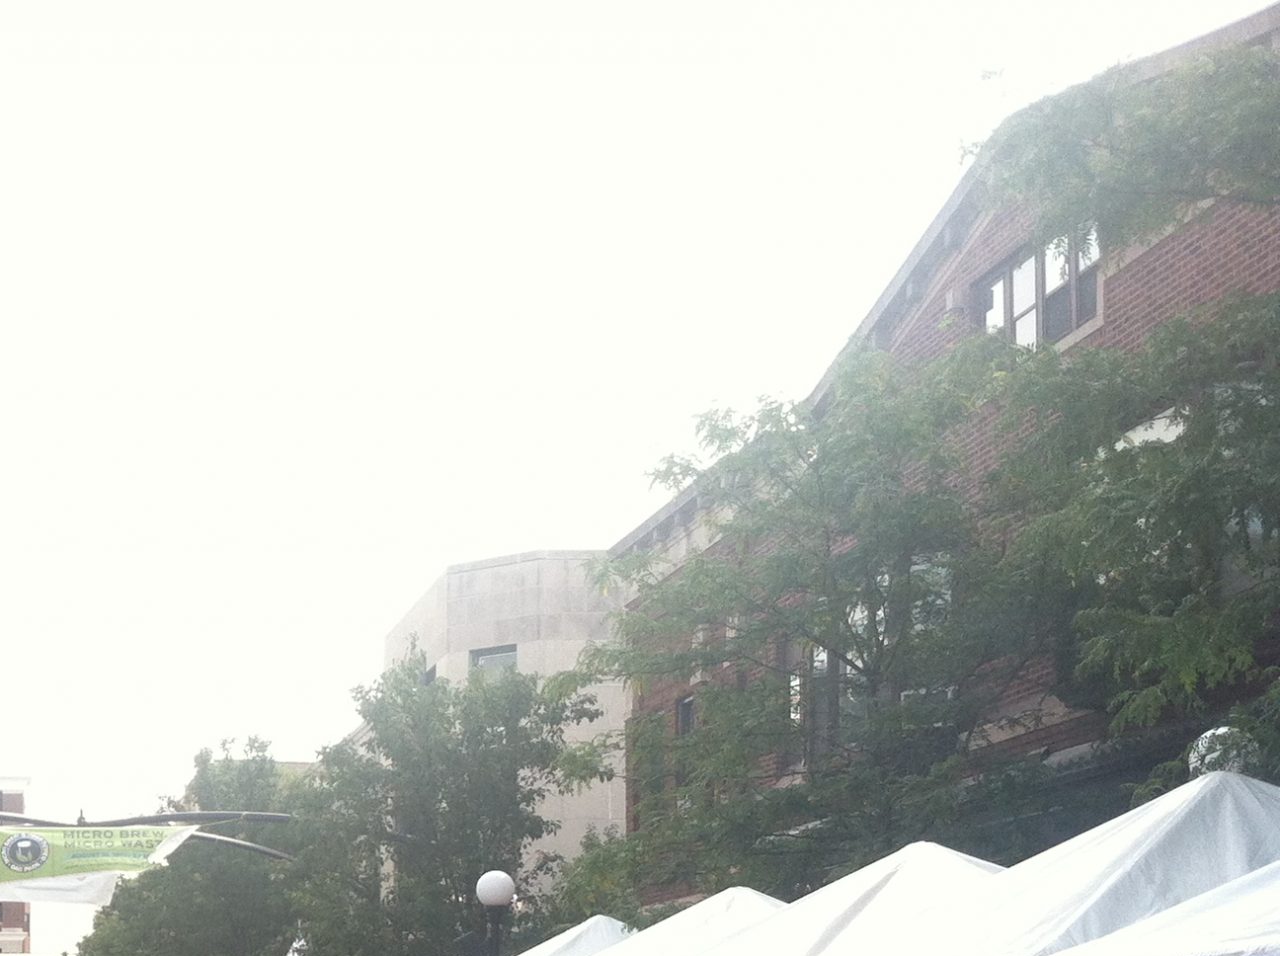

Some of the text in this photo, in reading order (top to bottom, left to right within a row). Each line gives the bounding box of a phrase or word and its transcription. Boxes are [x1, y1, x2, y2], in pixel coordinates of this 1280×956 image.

[63, 830, 113, 839] MICRO
[64, 840, 162, 849] MICRO WAST
